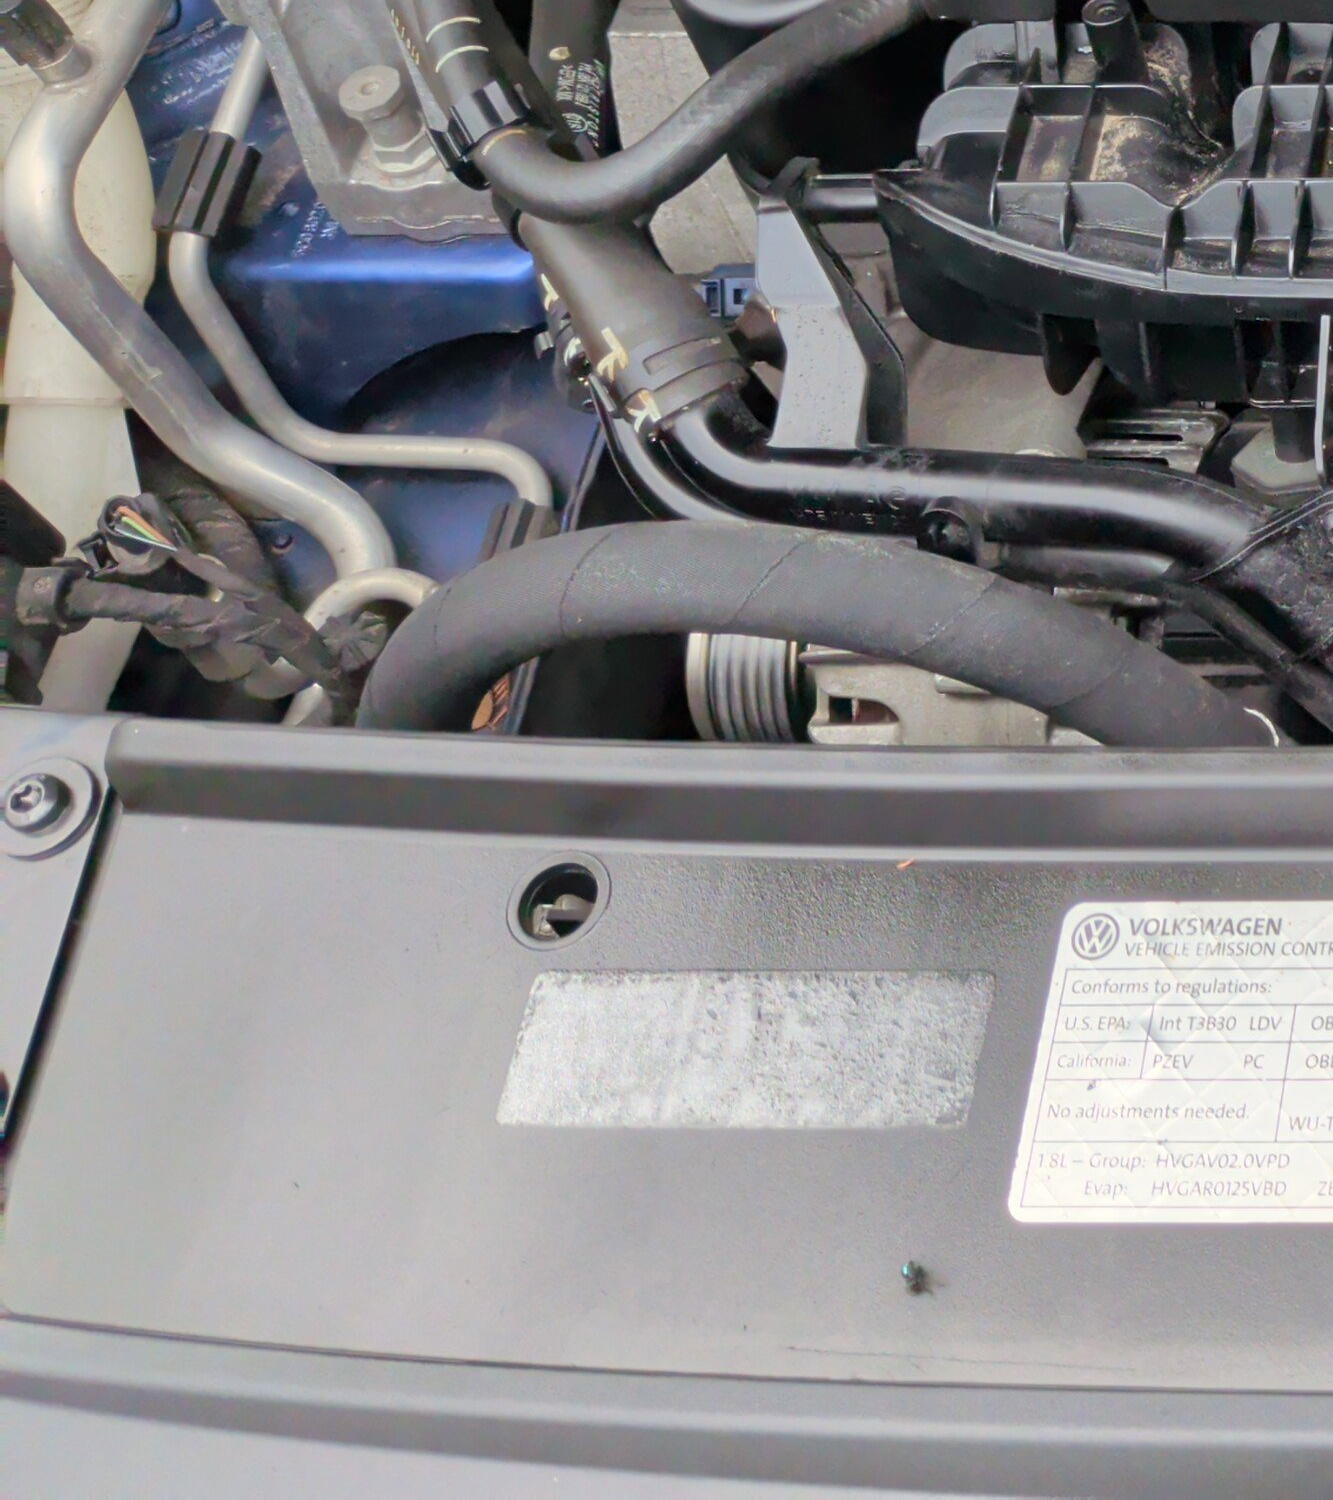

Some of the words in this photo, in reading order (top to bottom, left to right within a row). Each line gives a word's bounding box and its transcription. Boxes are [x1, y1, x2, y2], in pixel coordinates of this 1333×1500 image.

[1129, 918, 1283, 936] VOLKSWAGEN
[1125, 942, 1189, 957] VEHICLE
[1196, 942, 1276, 956] EMISSION
[1071, 979, 1149, 994] Conforms
[1154, 980, 1171, 994] to
[1176, 979, 1272, 999] regulations:
[1064, 1016, 1092, 1031] U.S.
[1097, 1016, 1131, 1031] EPA:
[1159, 1016, 1182, 1031] Int
[1249, 1016, 1283, 1031] LDV
[1057, 1054, 1131, 1068] California:
[1152, 1054, 1194, 1069] PZEV
[1243, 1054, 1266, 1069] PC
[1047, 1104, 1071, 1119] No
[1075, 1104, 1180, 1122] adjustments
[1183, 1103, 1250, 1119] needed.
[1037, 1153, 1068, 1168] 1.8L
[1089, 1153, 1147, 1172] Group:
[1084, 1181, 1128, 1200] Evap:
